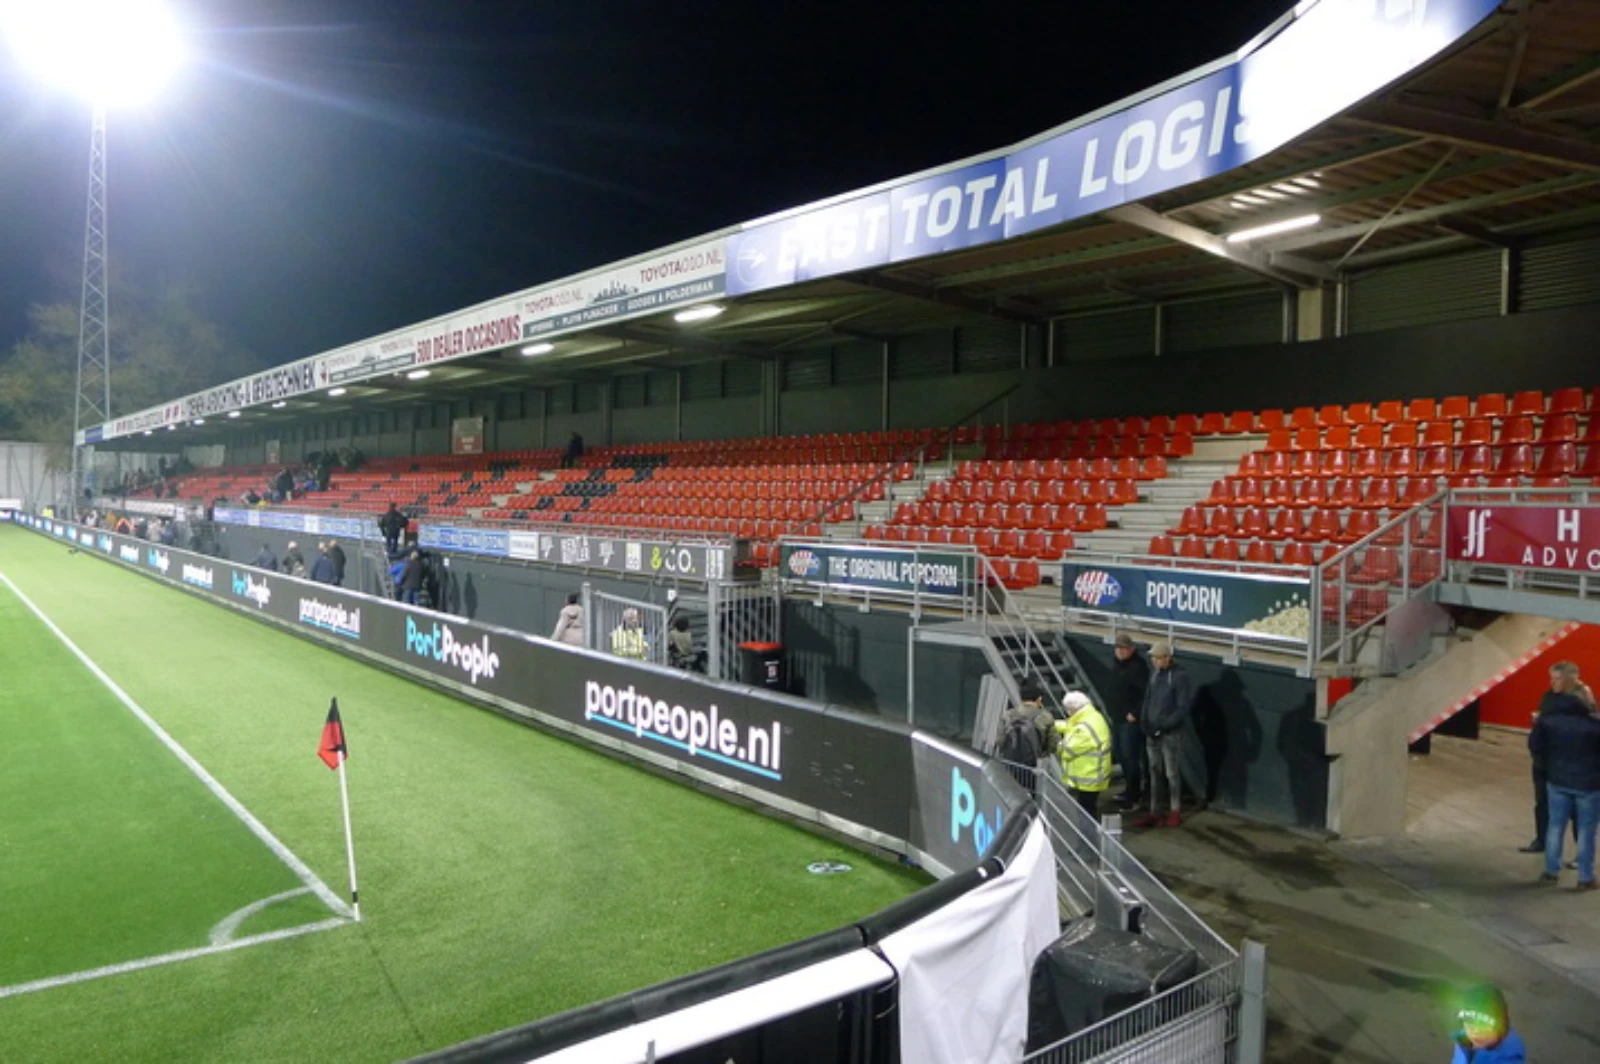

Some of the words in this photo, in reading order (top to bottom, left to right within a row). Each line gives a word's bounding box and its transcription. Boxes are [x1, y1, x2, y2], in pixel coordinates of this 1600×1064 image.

[901, 157, 1057, 245] TOTAL
[433, 330, 463, 360] DEALER
[464, 314, 521, 352] OCCASIONS
[827, 555, 848, 577] THE
[850, 557, 899, 582] ORIGINAL
[901, 562, 958, 588] POPCORN
[300, 597, 361, 635] portpeople.nl
[1145, 580, 1224, 616] POPCORN
[585, 680, 781, 771] portpeople.nl
